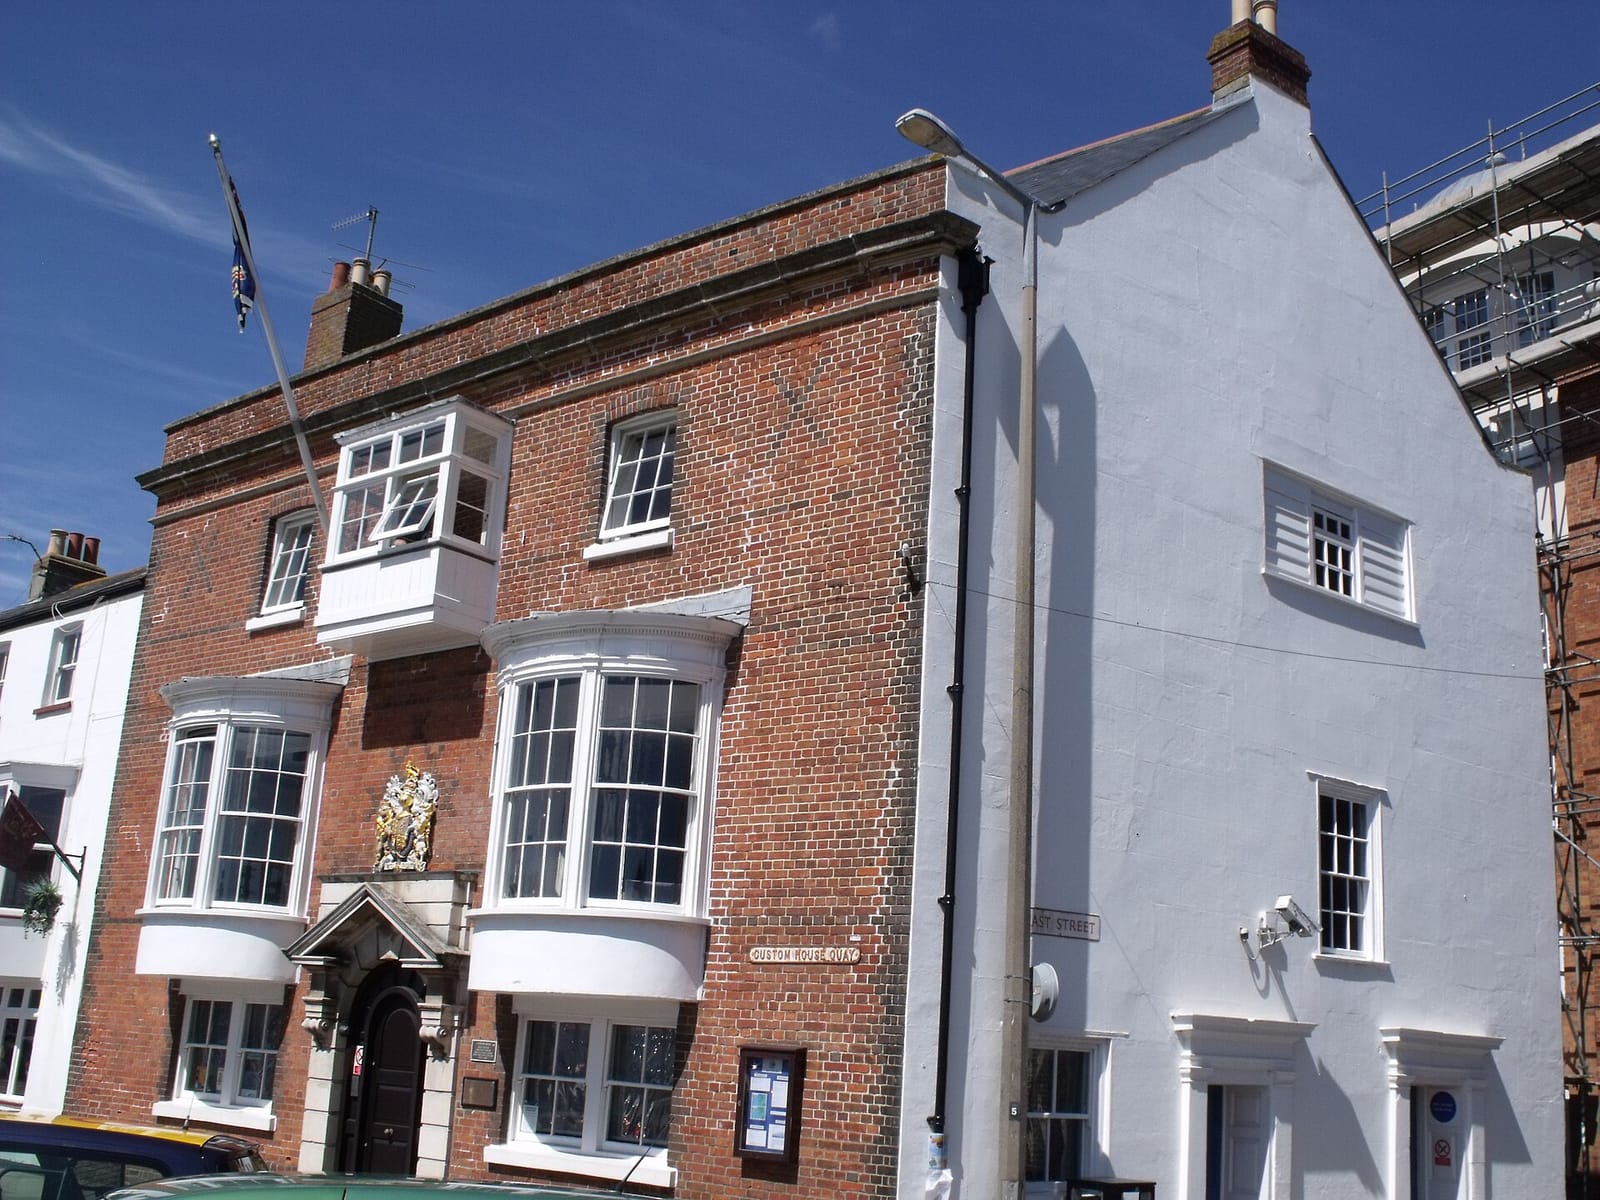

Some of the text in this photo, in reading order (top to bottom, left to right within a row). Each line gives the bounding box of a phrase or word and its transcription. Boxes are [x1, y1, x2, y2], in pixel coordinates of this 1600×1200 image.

[1032, 915, 1095, 934] AST STREET
[754, 949, 855, 961] CUSTOM HOUSE QUAY
[1011, 1107, 1017, 1116] 5
